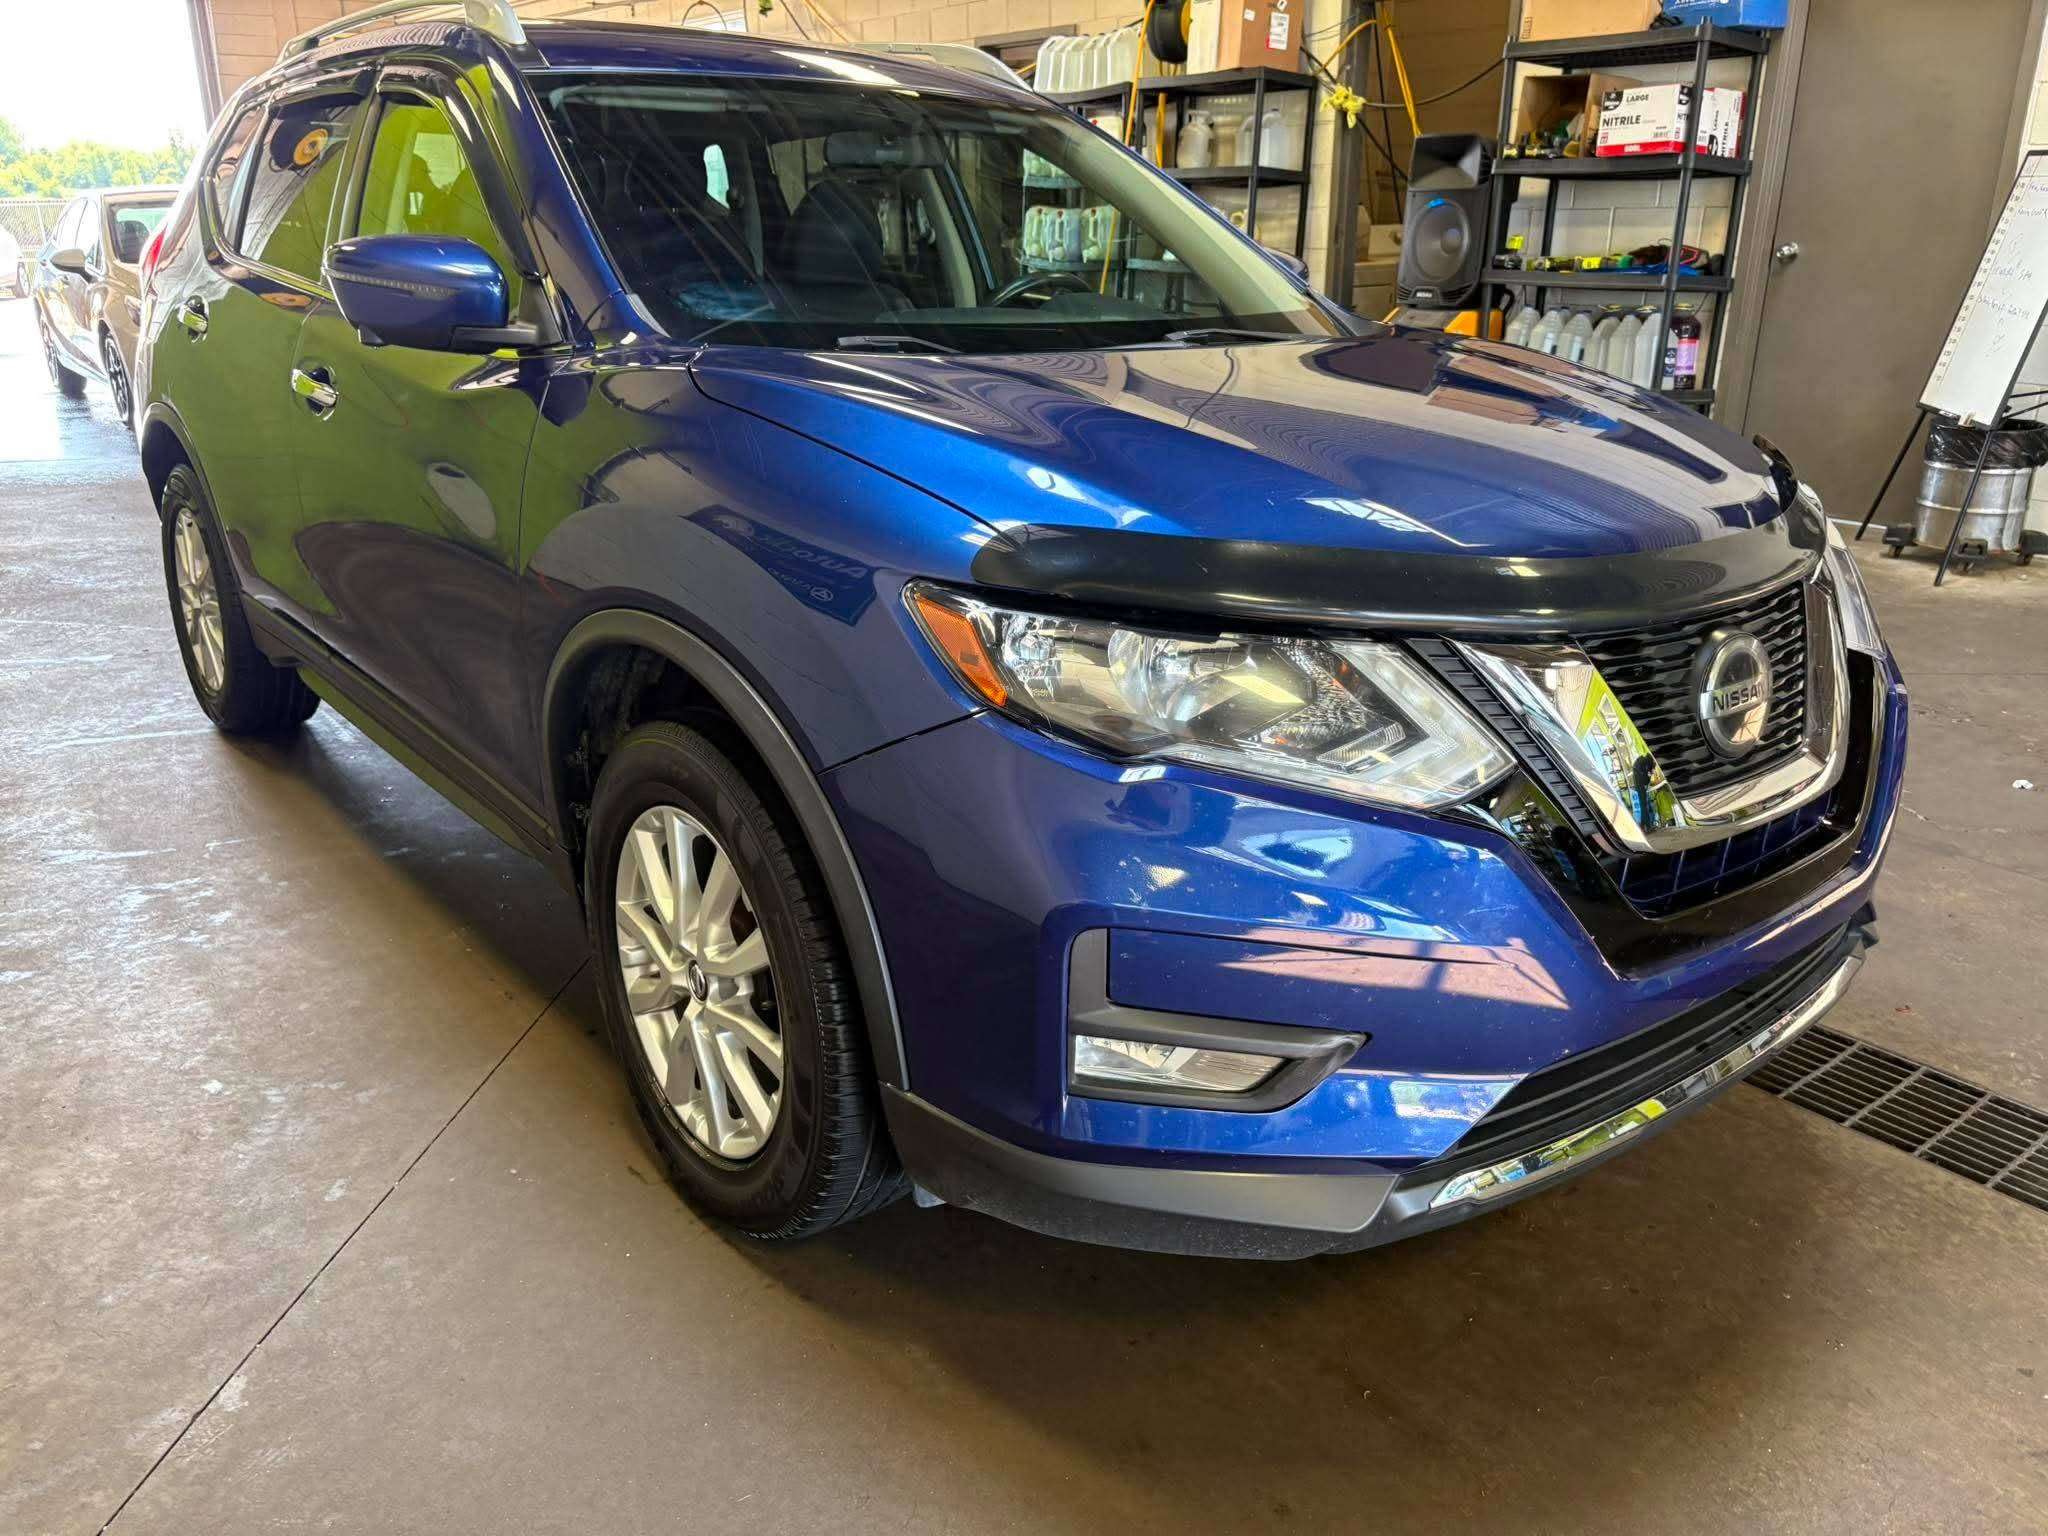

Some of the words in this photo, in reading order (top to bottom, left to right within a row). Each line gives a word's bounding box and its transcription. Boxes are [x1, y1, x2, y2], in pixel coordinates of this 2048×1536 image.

[1626, 94, 1649, 103] LARGE
[1602, 114, 1642, 128] NITRILE
[1713, 684, 1765, 711] NISSAN
